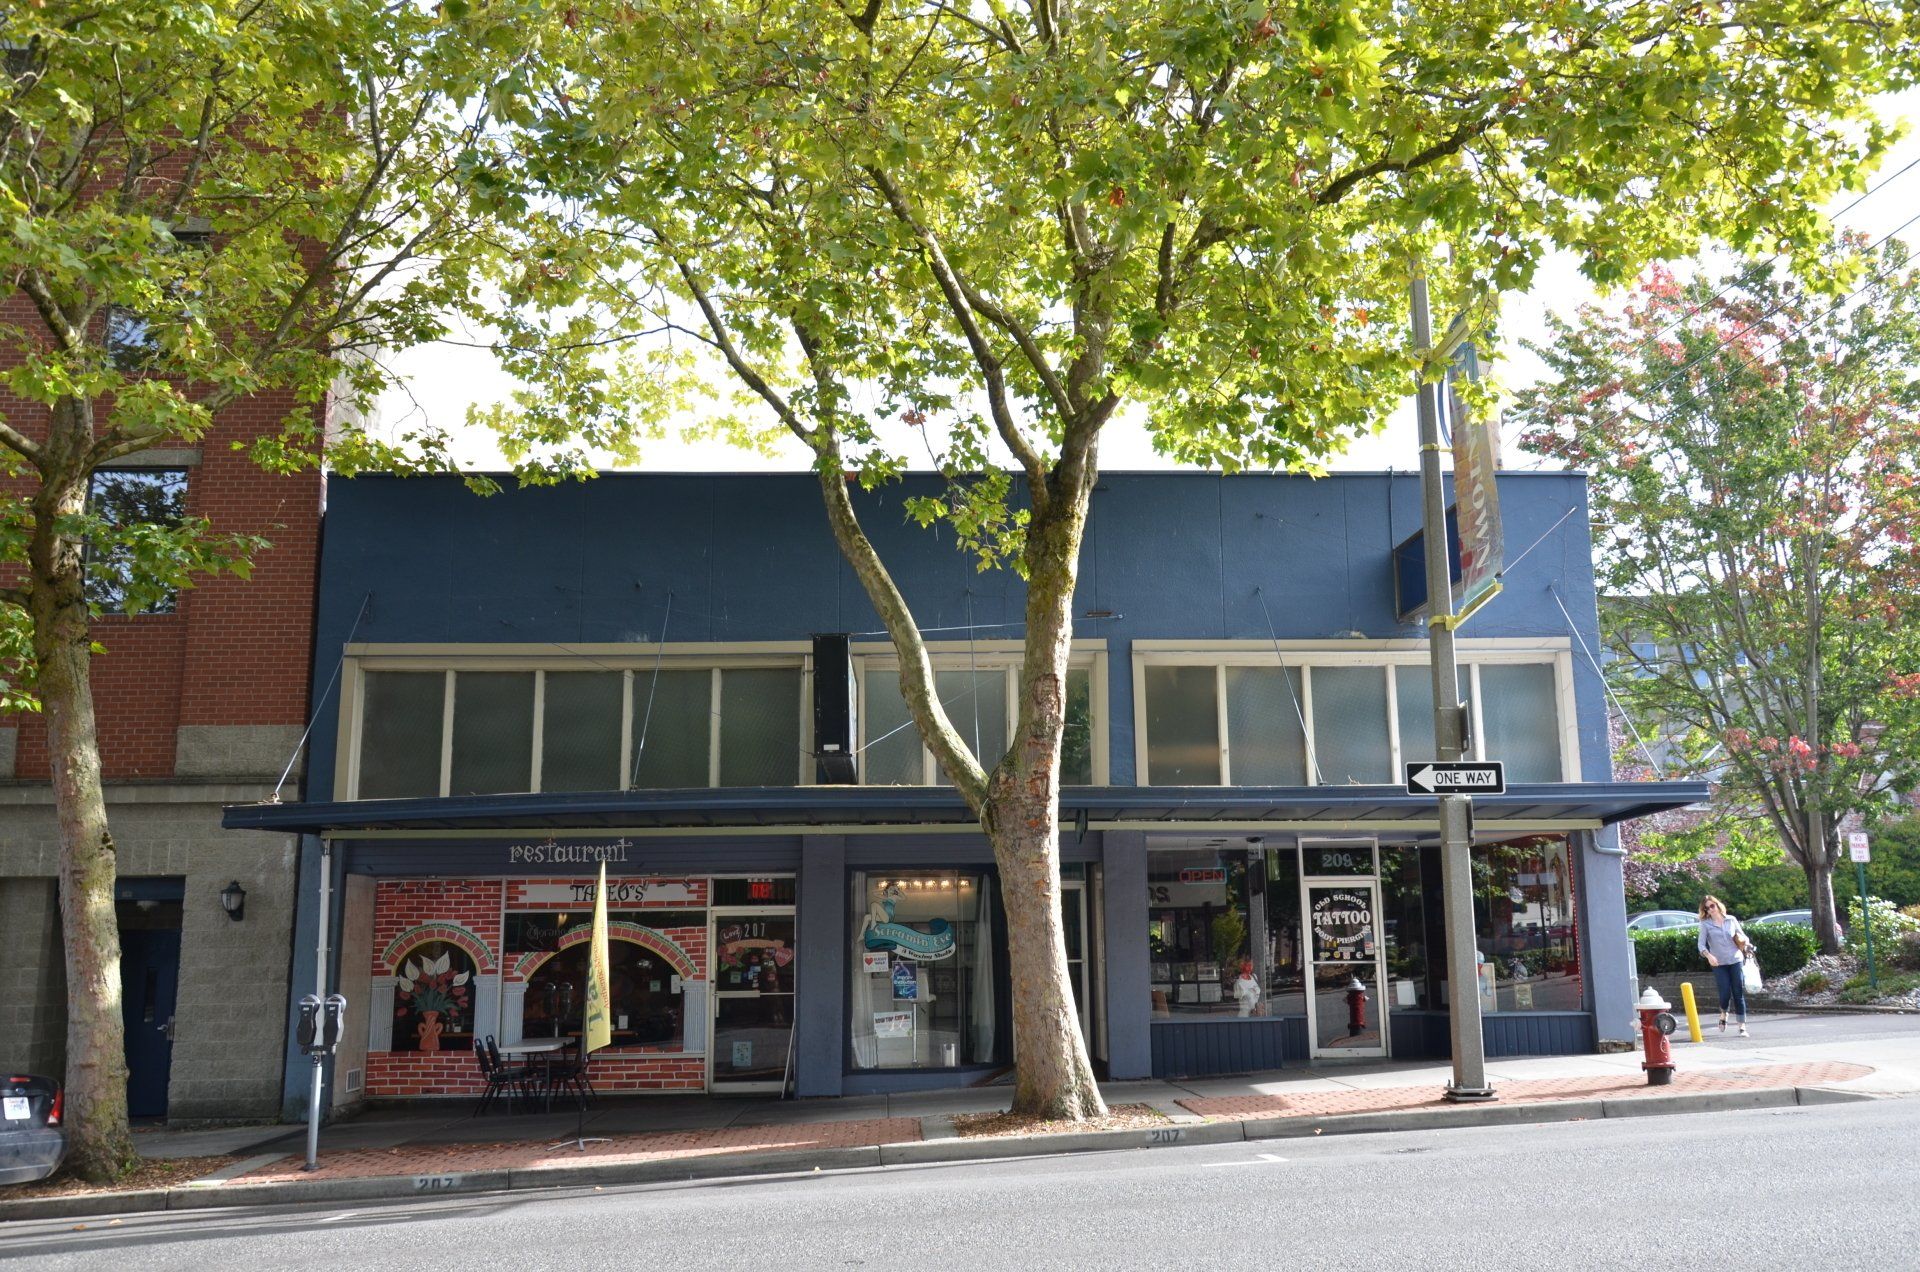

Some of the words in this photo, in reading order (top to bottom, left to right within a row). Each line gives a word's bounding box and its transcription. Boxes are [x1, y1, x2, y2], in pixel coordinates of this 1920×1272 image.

[1435, 772, 1461, 785] ONE
[1465, 772, 1492, 784] WAY
[508, 837, 633, 863] restaurant
[1321, 853, 1353, 868] 209
[1180, 870, 1224, 883] OPEN
[569, 884, 644, 902] TAEO'S
[1314, 896, 1331, 911] OLD
[1333, 894, 1367, 909] SCHOOL
[1312, 910, 1371, 926] TATTOO
[744, 922, 766, 938] 207
[1314, 926, 1335, 943] BODY
[1151, 1129, 1180, 1143] 207
